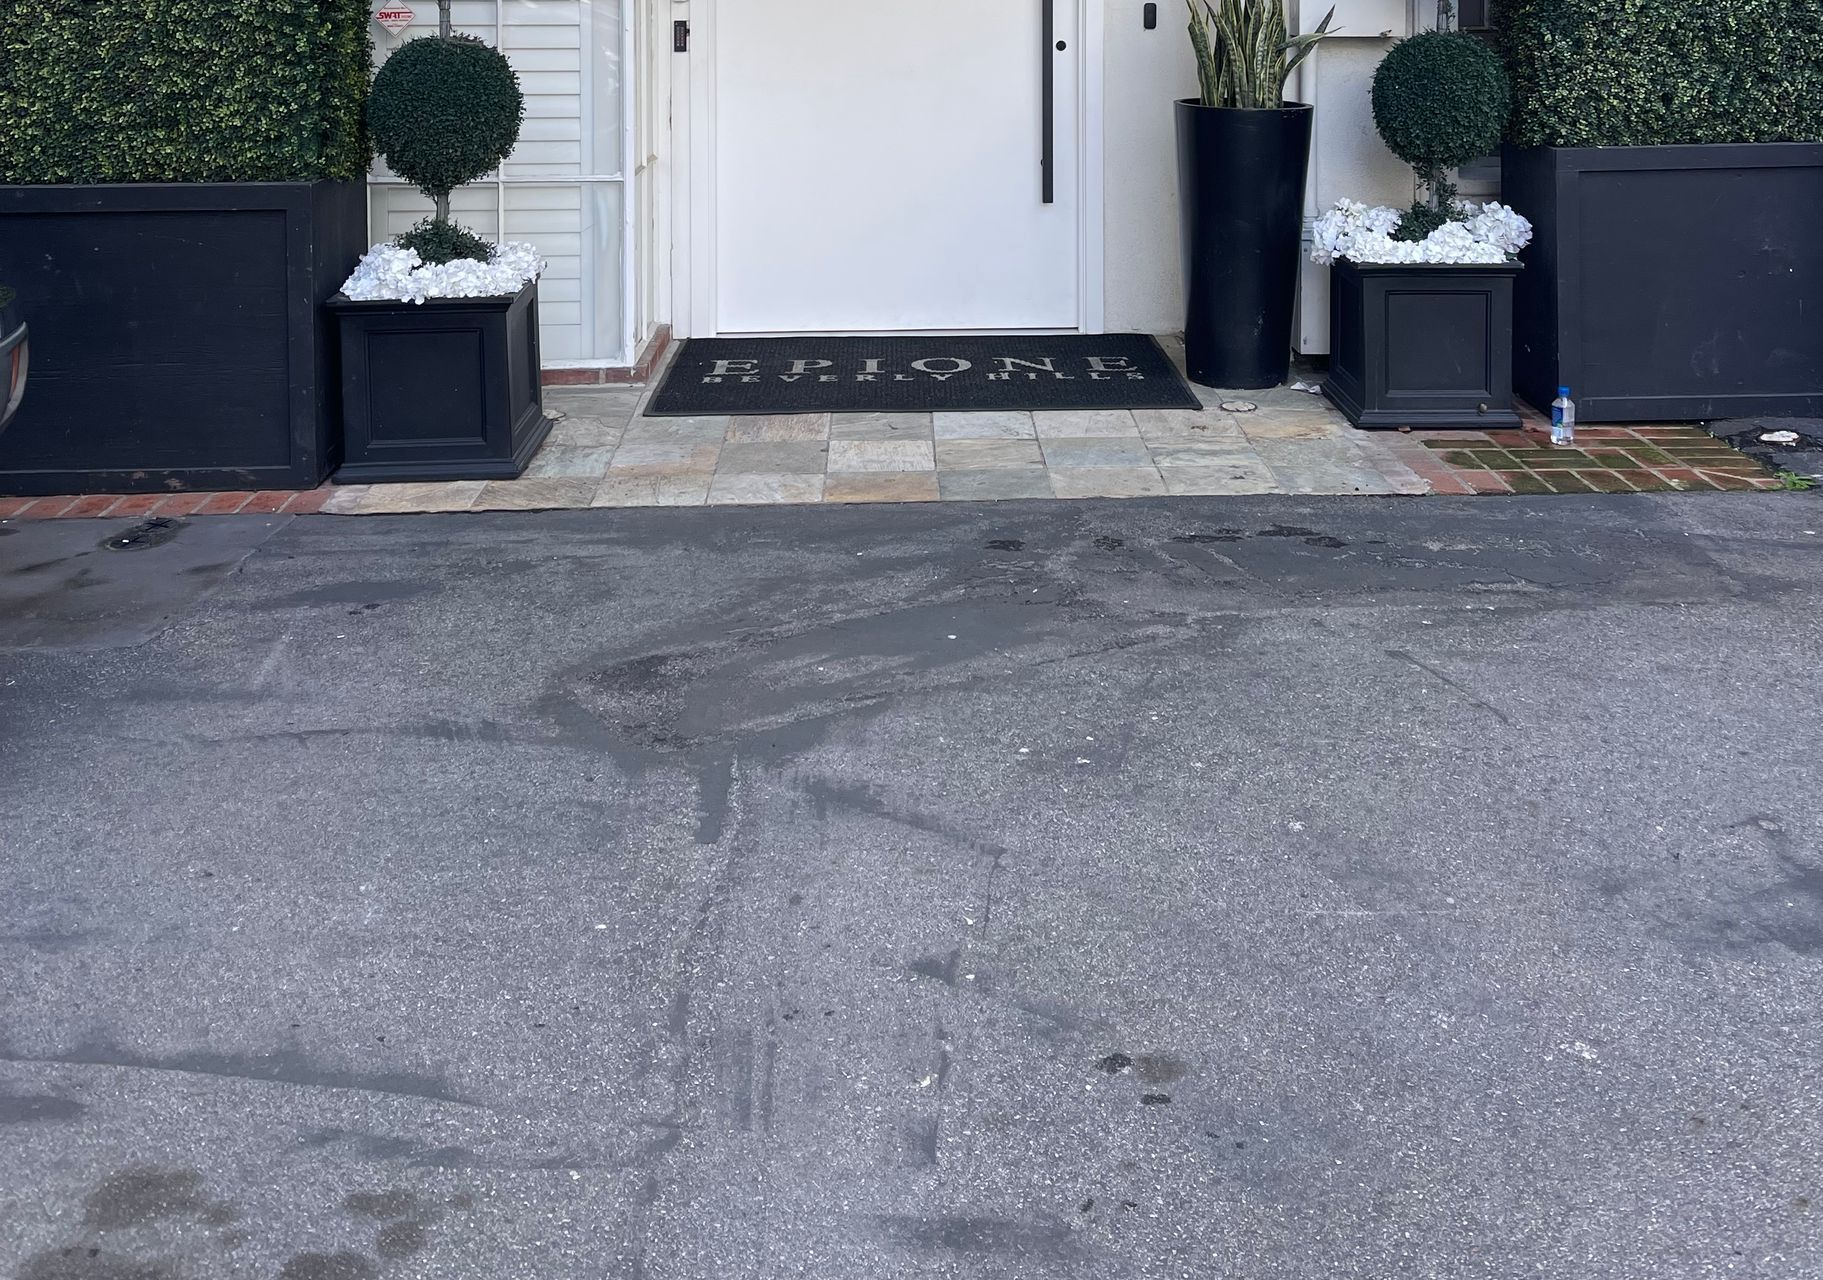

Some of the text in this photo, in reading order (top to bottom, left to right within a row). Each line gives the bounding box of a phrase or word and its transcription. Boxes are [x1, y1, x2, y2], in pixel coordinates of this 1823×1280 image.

[705, 357, 1138, 376] EPIONE
[701, 372, 1145, 383] BEVERLY HILLS
